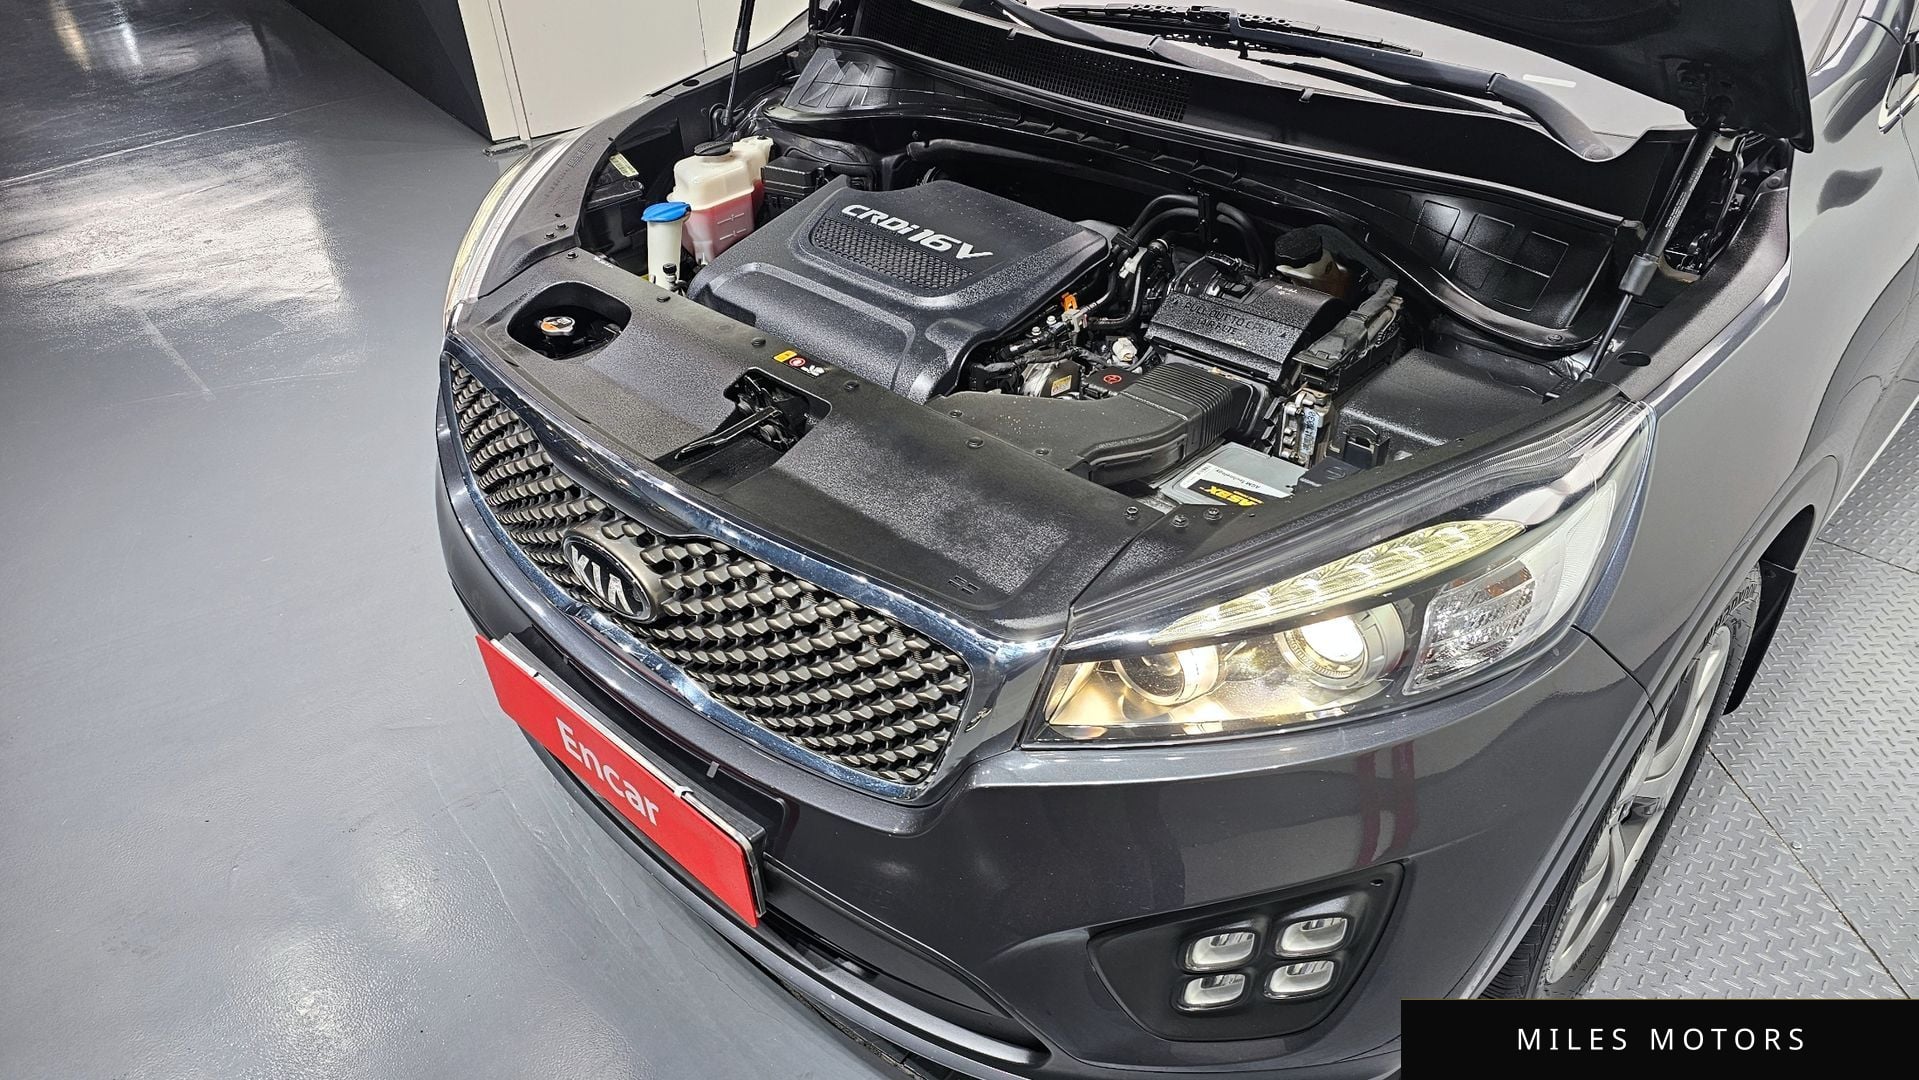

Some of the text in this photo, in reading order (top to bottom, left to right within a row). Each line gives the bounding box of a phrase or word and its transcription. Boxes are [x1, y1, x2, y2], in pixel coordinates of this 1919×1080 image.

[1209, 310, 1230, 323] OUT
[1229, 315, 1244, 327] TO
[571, 545, 634, 615] KIA
[555, 716, 660, 826] Encar
